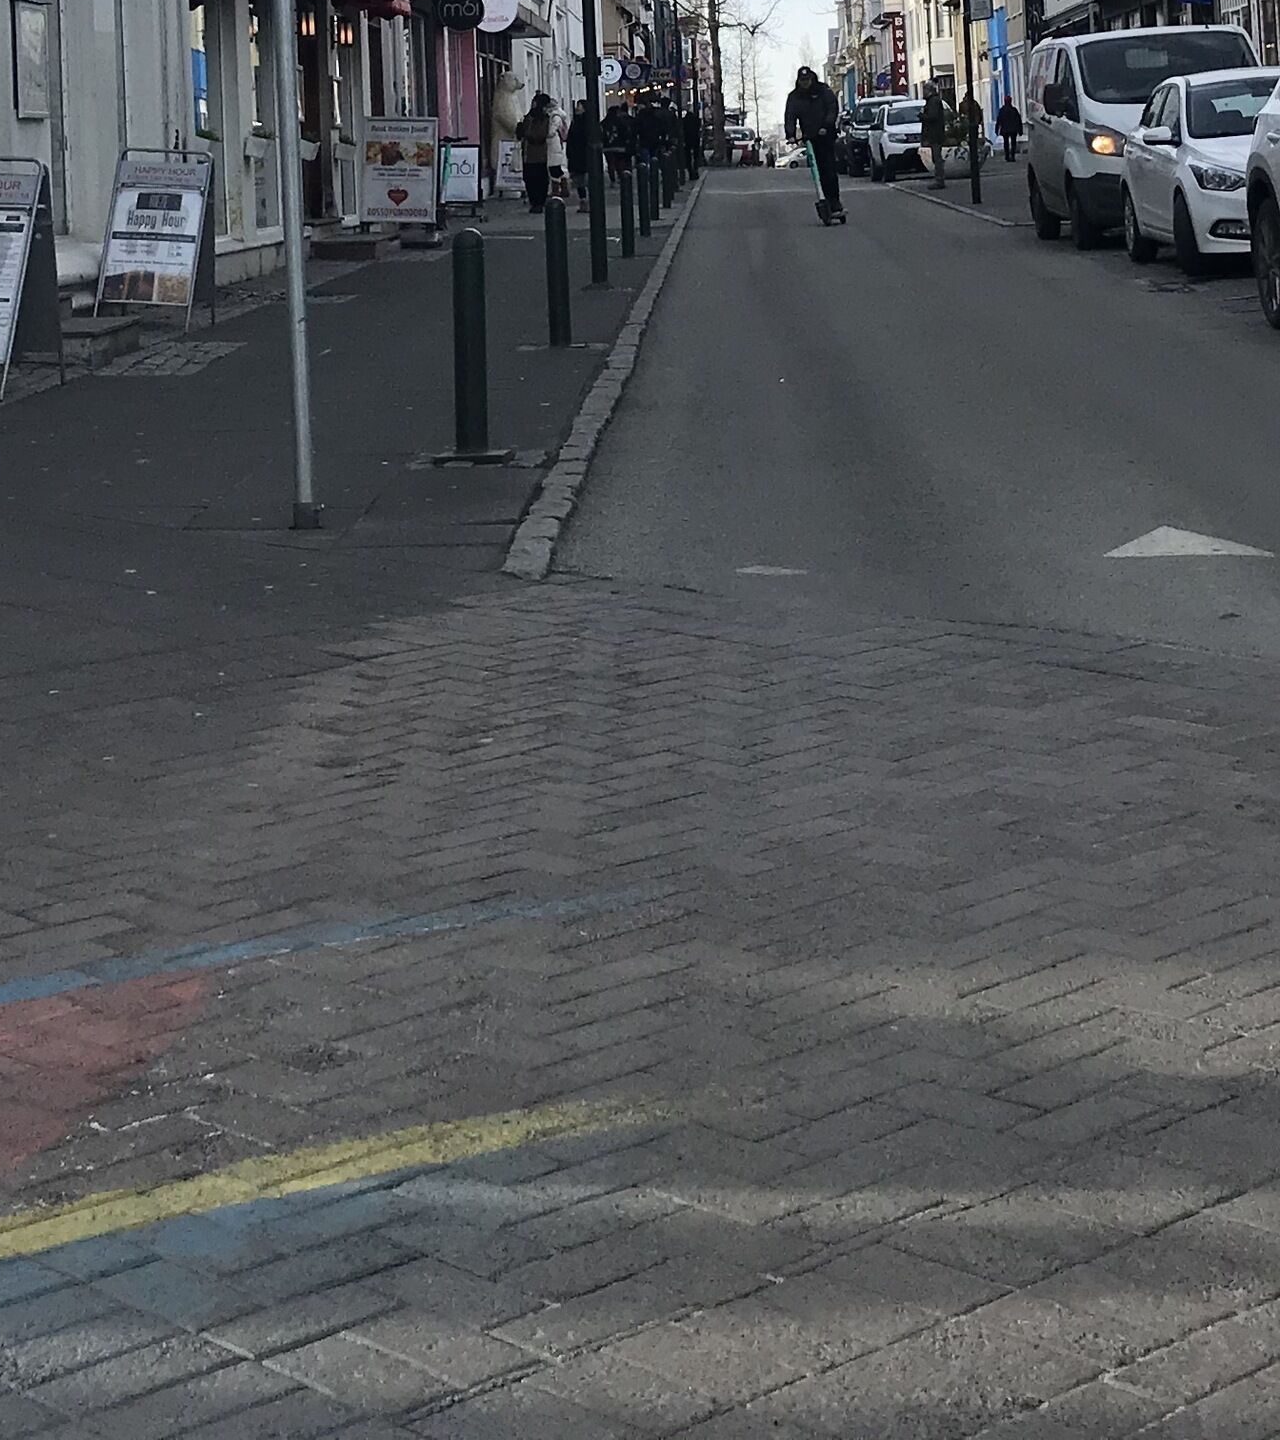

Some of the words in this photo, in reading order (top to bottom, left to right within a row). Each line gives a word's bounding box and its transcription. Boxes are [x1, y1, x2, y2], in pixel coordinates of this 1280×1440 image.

[894, 16, 908, 86] BRYNJA
[126, 210, 157, 230] Happy
[161, 210, 186, 228] Hour
